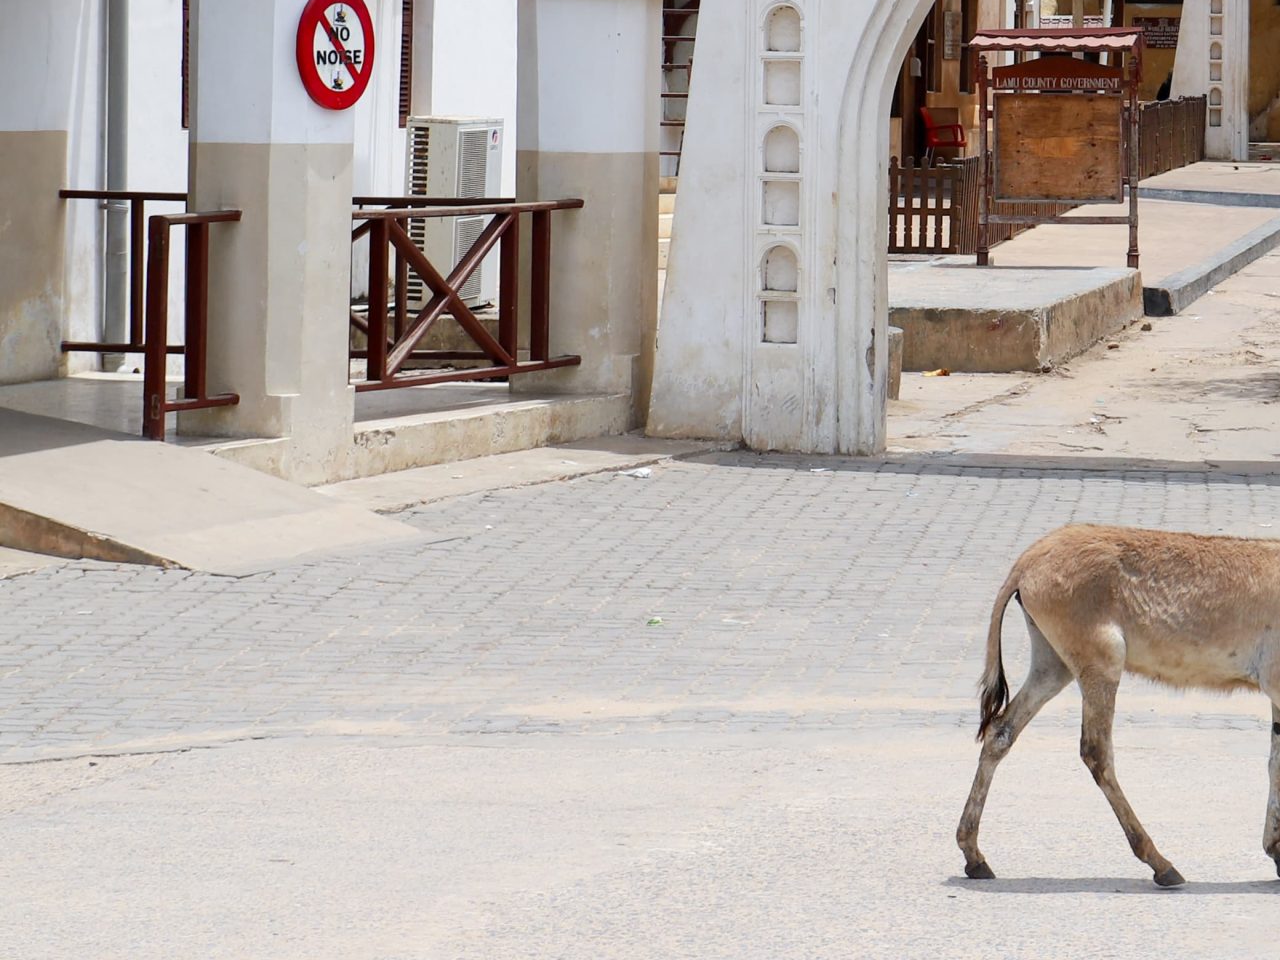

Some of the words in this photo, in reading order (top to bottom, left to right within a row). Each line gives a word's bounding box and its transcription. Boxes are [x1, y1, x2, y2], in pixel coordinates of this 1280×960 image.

[329, 26, 350, 42] NO
[316, 50, 362, 65] NOISE
[996, 77, 1019, 89] LAMU
[1022, 77, 1057, 89] COUNTY
[1060, 77, 1120, 89] GOVERNMENT
